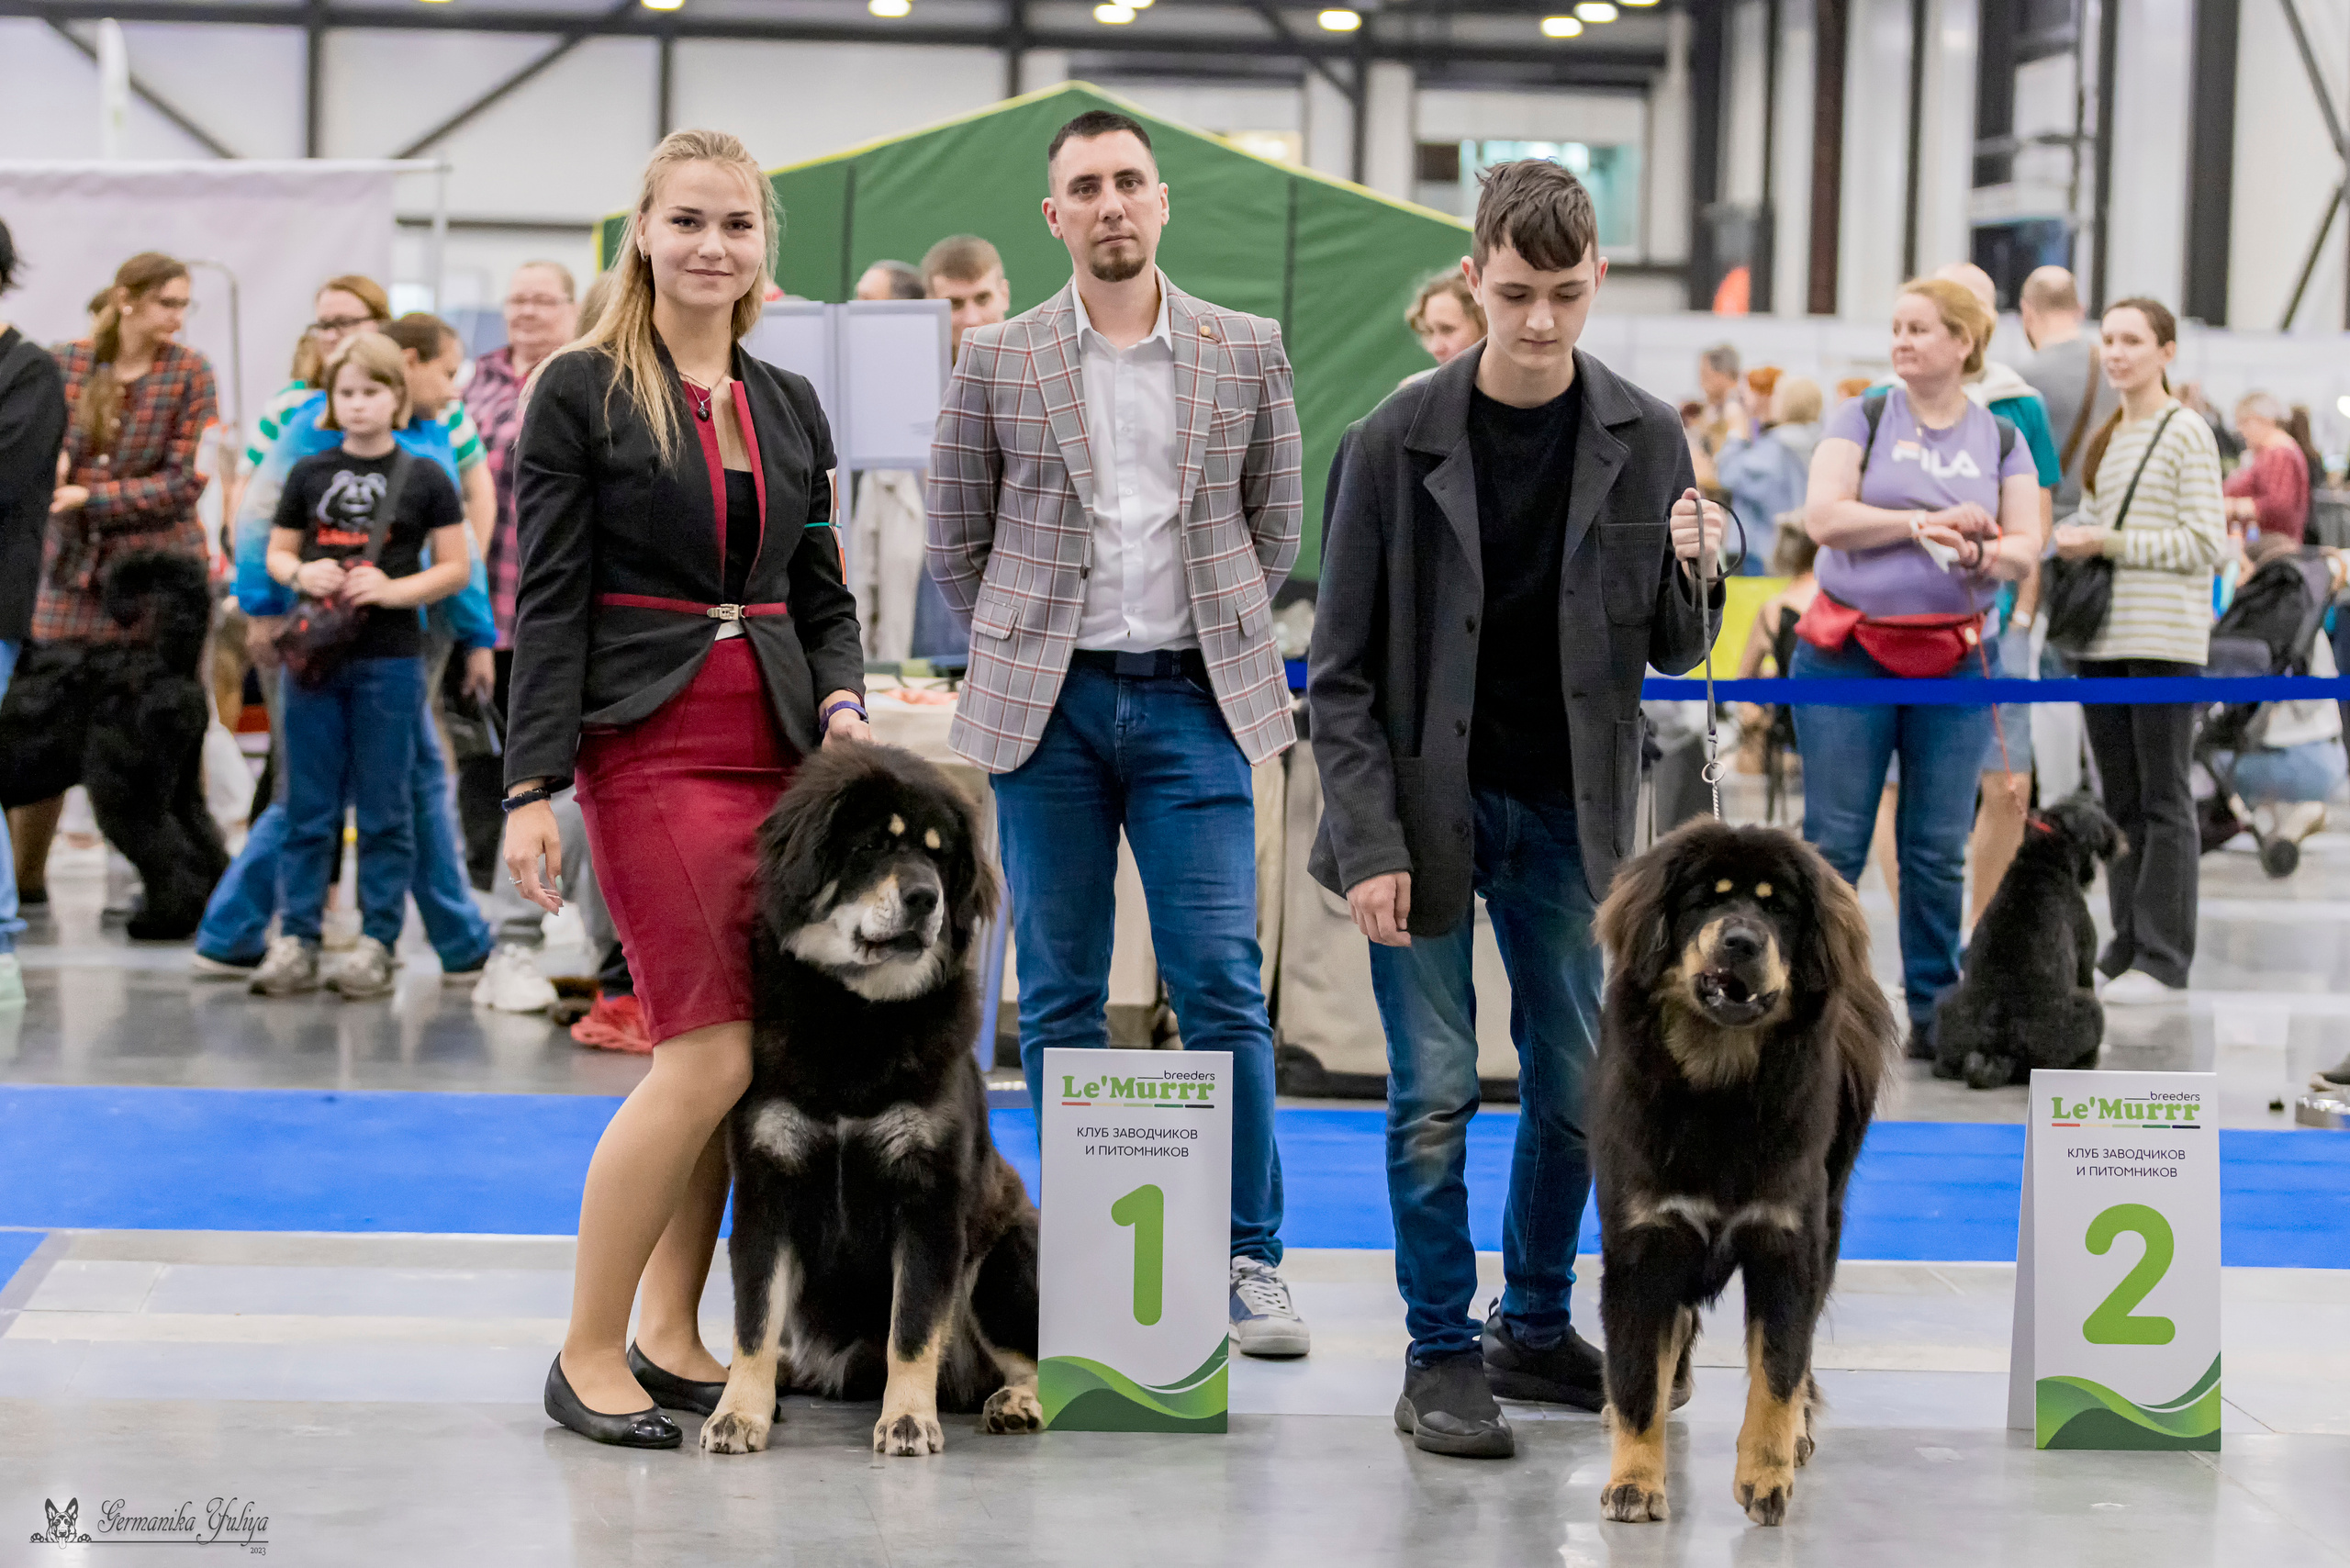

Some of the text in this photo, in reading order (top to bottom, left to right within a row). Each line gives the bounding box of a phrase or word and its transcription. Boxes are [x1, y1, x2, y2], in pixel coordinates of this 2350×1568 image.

[1891, 440, 1981, 478] FILA
[1164, 1070, 1215, 1081] breeders
[1061, 1075, 1215, 1100] Le'Murrr
[2150, 1092, 2200, 1102] breeders
[2051, 1096, 2200, 1121] Le'Murrr
[1077, 1127, 1198, 1140] КЛУБ ЗАВОДЧИКОВ
[1085, 1146, 1190, 1157] И ПИТОМНИКОВ
[2067, 1148, 2186, 1160] КЛУБ ЗАВОДЧИКОВ
[2076, 1166, 2177, 1178] И ПИТОМНИКОВ
[1111, 1183, 1164, 1326] 1
[2082, 1203, 2176, 1345] 2
